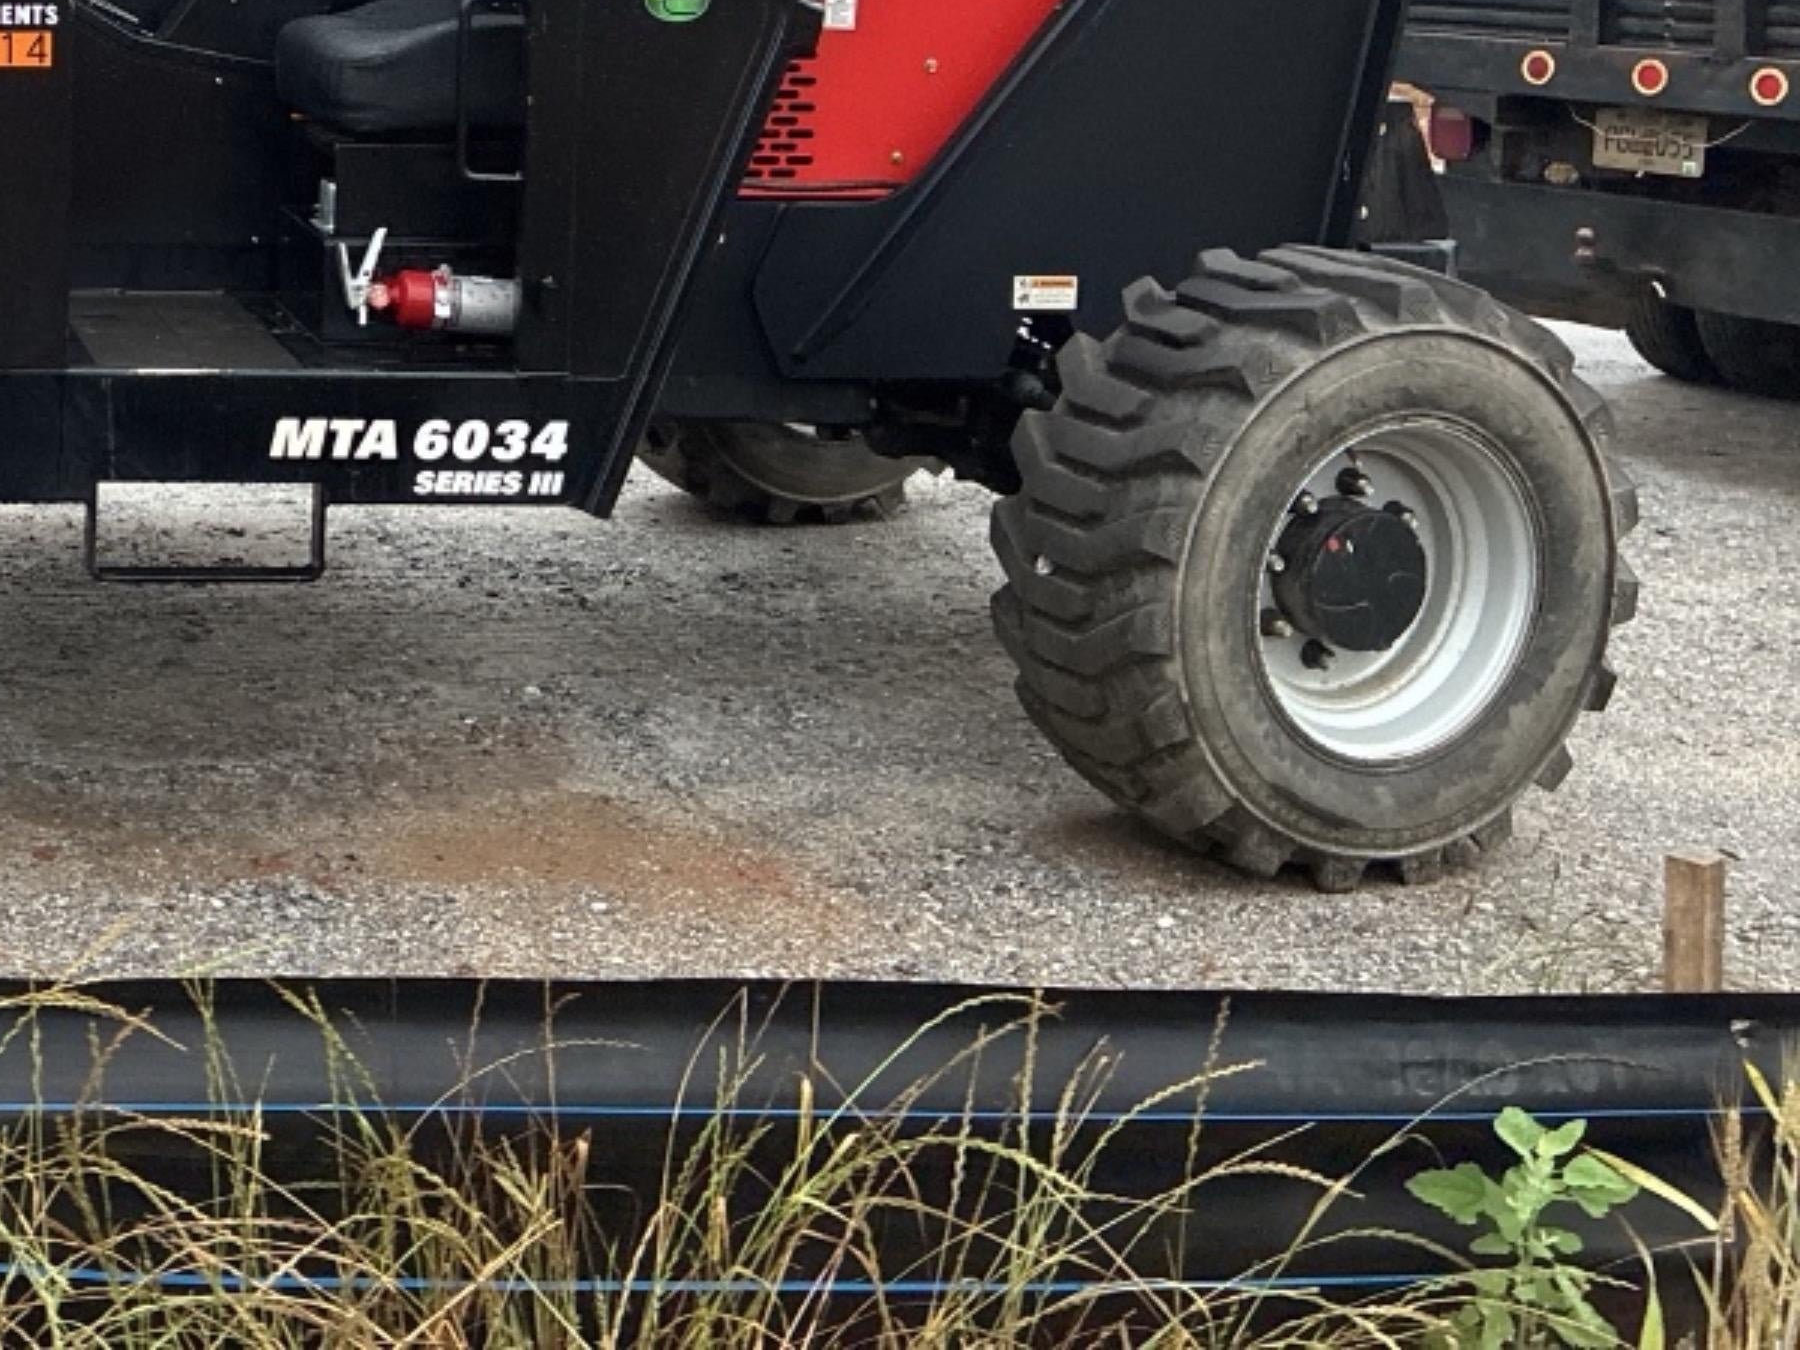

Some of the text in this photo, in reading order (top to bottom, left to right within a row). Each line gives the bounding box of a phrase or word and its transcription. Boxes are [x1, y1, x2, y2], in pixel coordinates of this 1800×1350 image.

[269, 417, 569, 461] MTA 6034
[413, 470, 565, 496] SERIES III
